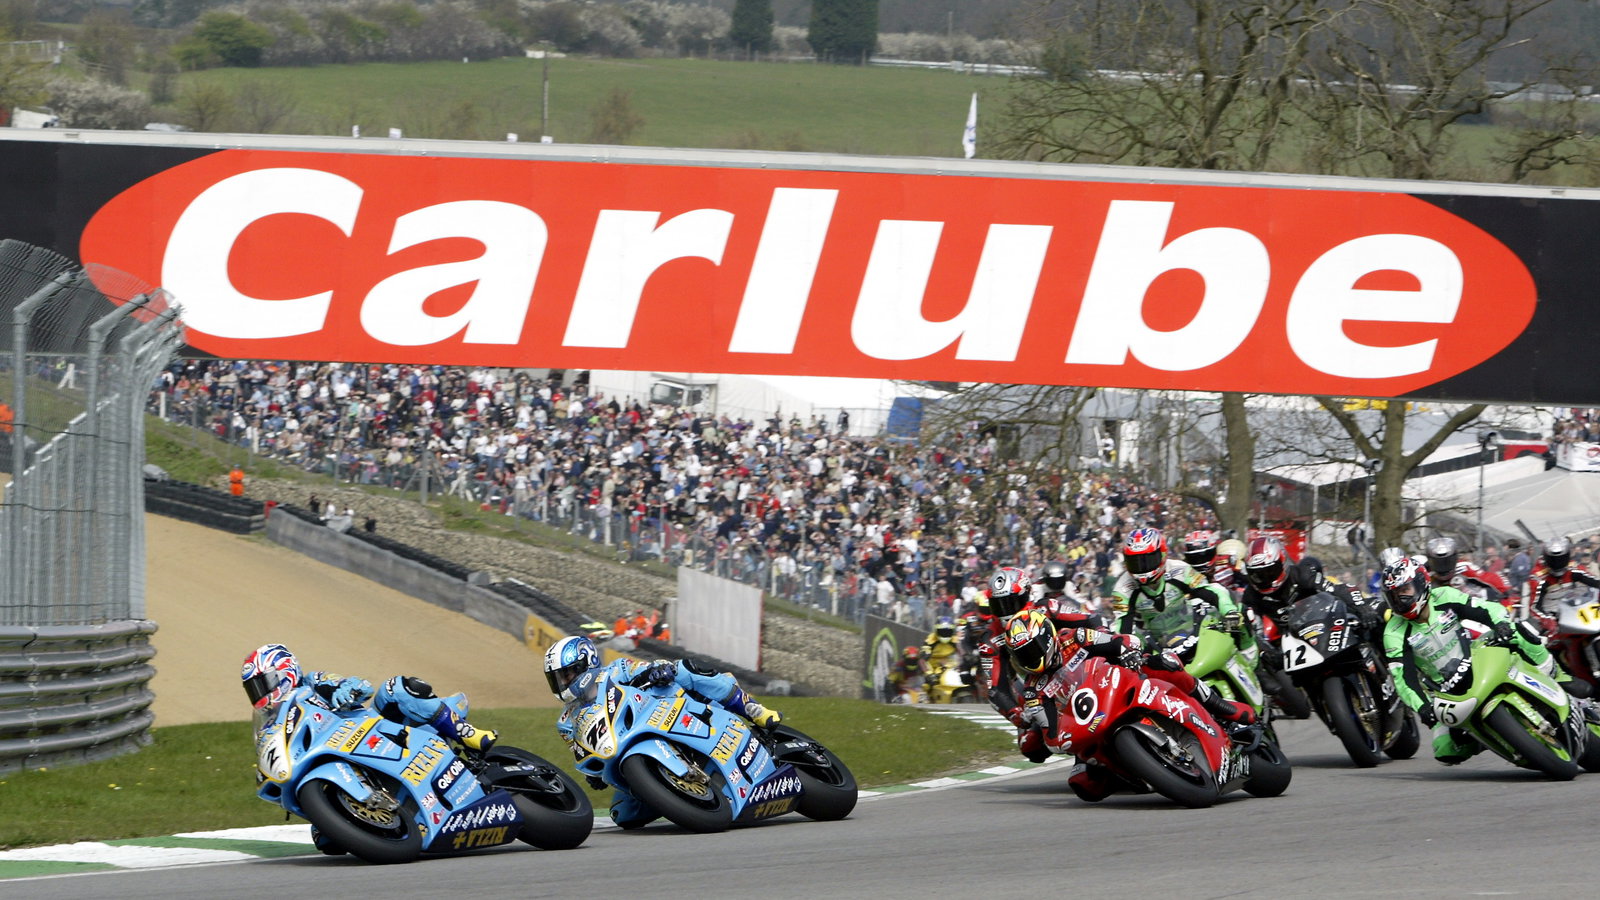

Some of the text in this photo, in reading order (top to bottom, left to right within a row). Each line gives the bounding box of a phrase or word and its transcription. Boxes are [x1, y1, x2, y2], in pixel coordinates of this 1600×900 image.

[160, 166, 1464, 379] Carlube
[1327, 618, 1345, 652] sendo
[1284, 645, 1306, 669] 12
[663, 706, 678, 728] SUZUKI
[1074, 691, 1095, 721] 6
[345, 727, 366, 749] SUZUKI
